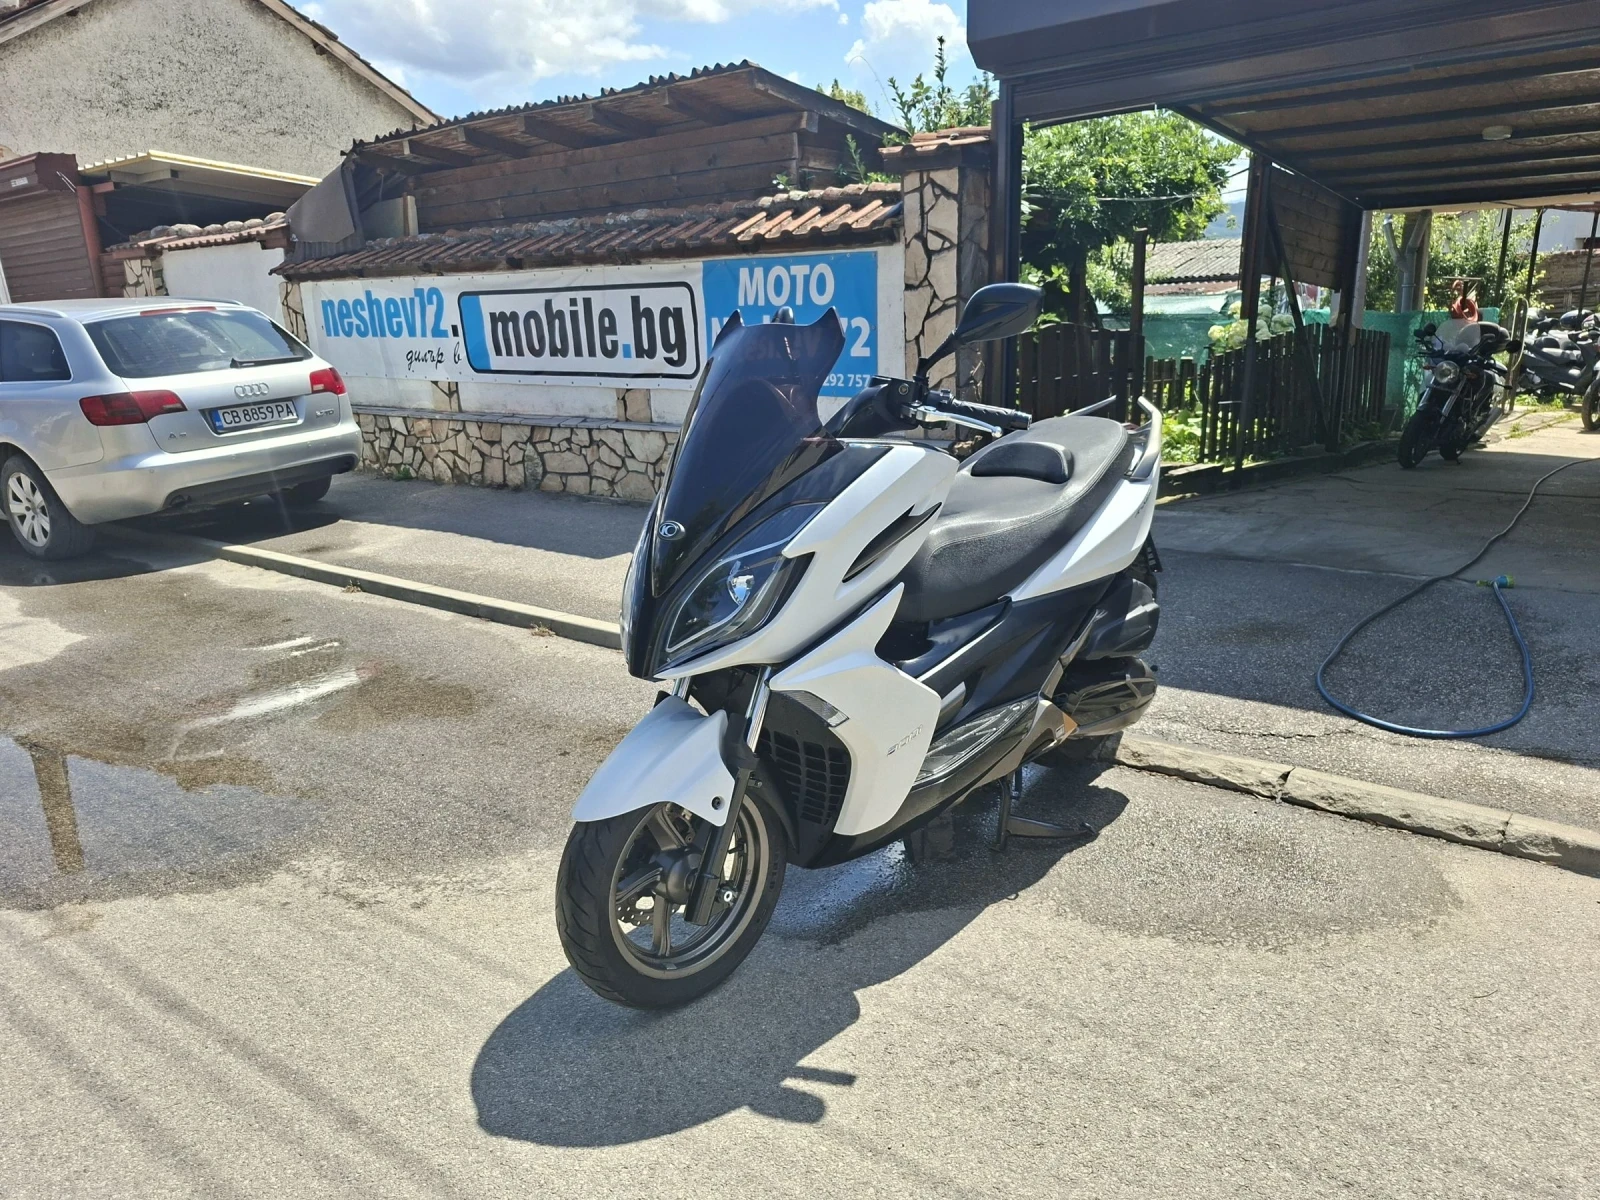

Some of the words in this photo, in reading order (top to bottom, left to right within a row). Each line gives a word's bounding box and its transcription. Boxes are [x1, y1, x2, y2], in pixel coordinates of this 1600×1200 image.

[738, 263, 835, 307] MOTO
[489, 295, 687, 368] mobile.bg
[847, 373, 871, 388] 757
[221, 409, 242, 425] CB
[243, 406, 275, 422] 8859
[276, 402, 294, 418] PA
